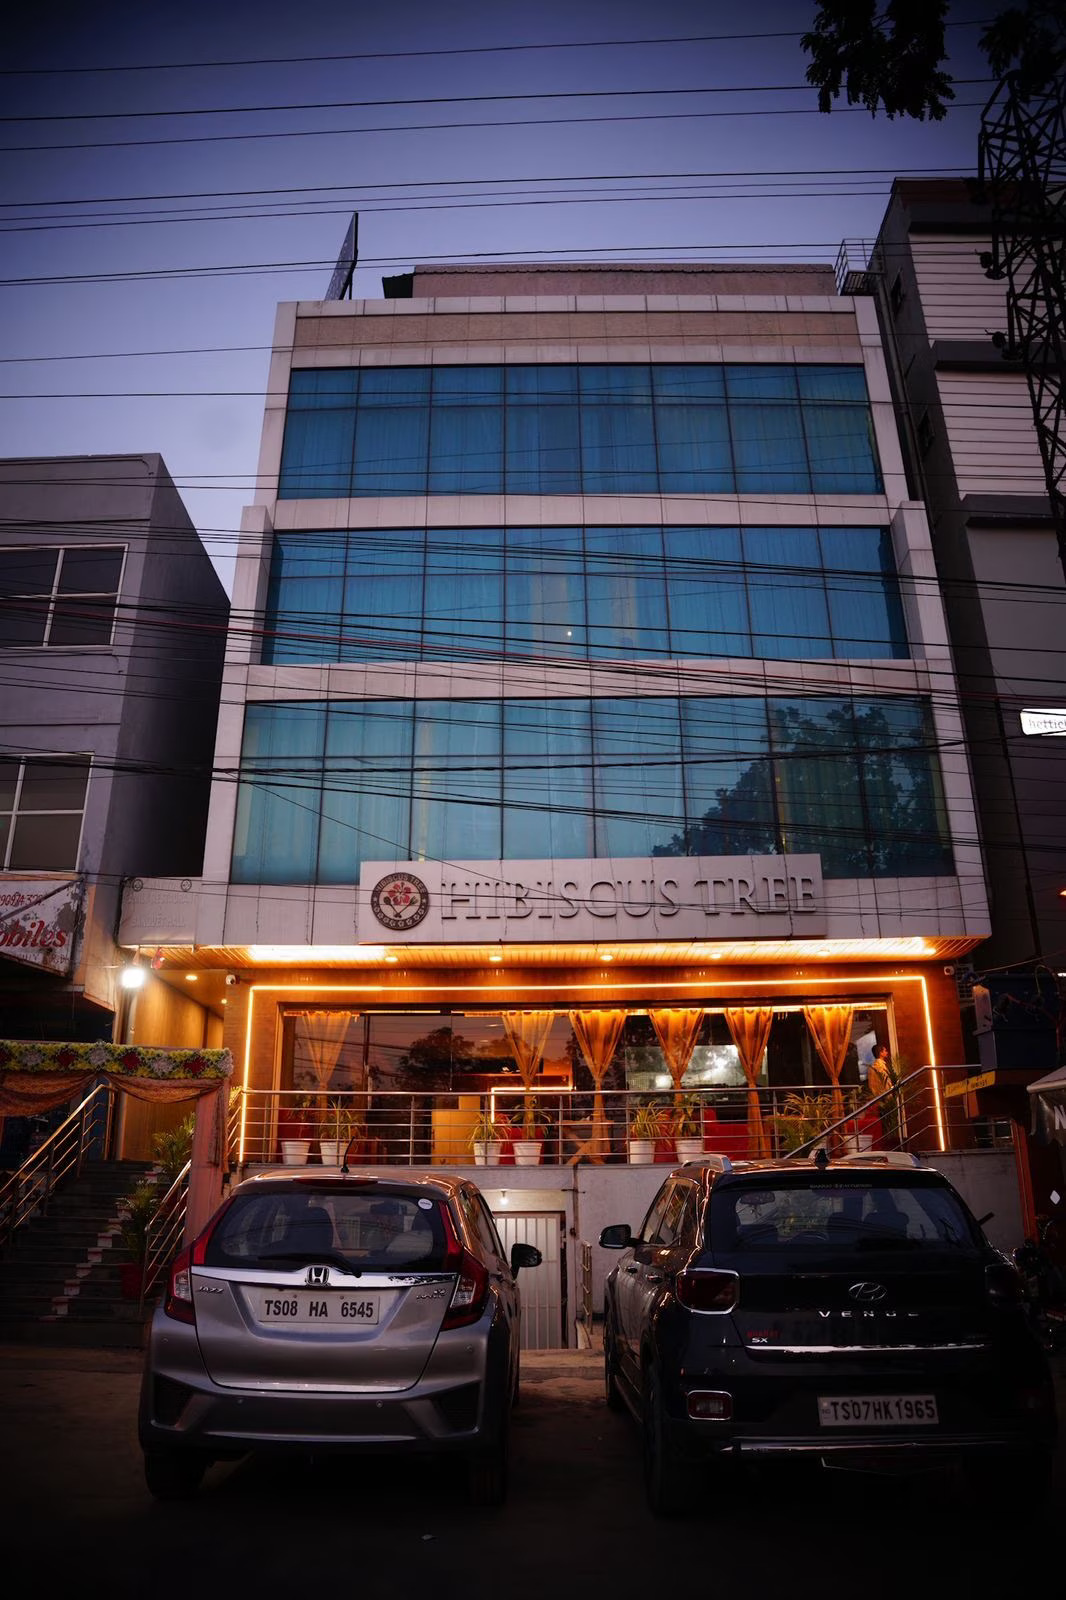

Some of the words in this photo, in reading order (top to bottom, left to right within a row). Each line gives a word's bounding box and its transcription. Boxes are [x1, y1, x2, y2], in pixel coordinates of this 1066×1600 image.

[375, 874, 409, 891] HIBISCUS
[410, 876, 427, 893] TREE
[440, 878, 680, 920] HIBISCUS
[694, 876, 817, 916] TREE
[264, 1299, 298, 1317] TS08
[308, 1301, 329, 1318] HA
[340, 1301, 374, 1319] 6545
[830, 1400, 935, 1421] TS07HK1965
